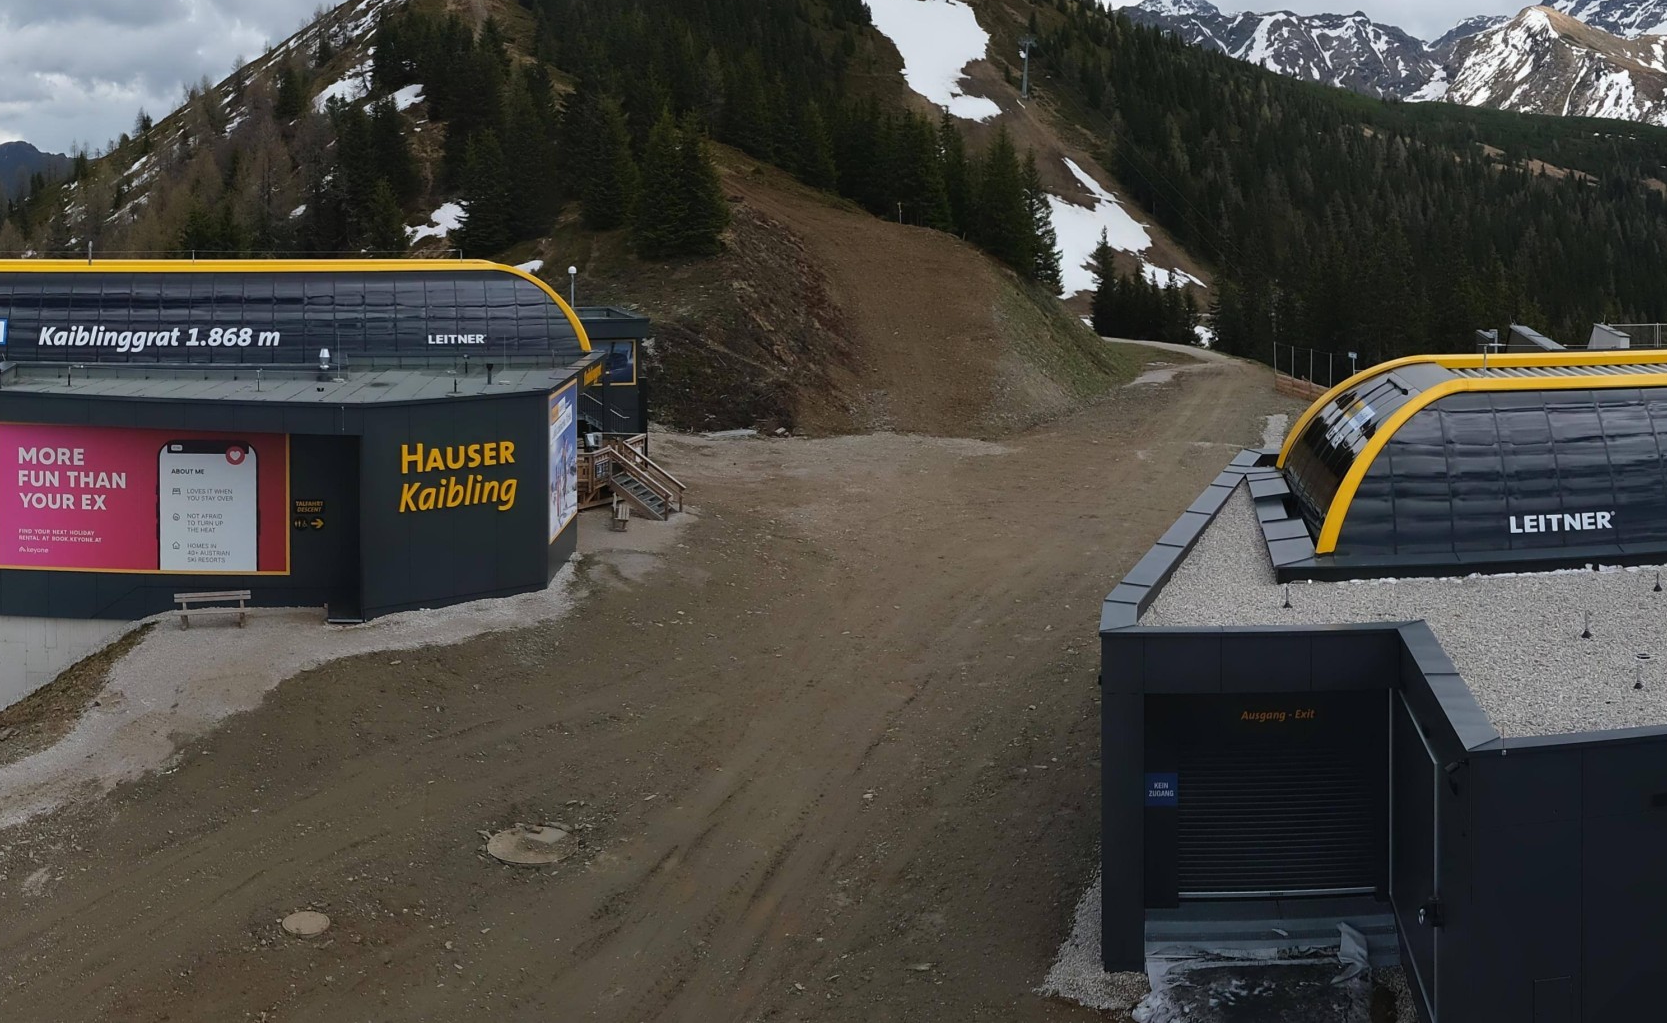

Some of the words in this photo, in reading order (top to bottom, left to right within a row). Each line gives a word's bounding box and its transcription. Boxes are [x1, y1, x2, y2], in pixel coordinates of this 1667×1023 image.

[38, 325, 180, 353] Kaiblinggrat
[185, 327, 252, 347] 1.868
[258, 331, 280, 347] m
[18, 447, 85, 465] MORE
[401, 441, 515, 474] HAUSER
[18, 470, 59, 487] FUN
[67, 471, 126, 489] THAN
[19, 493, 74, 509] YOUR
[81, 494, 106, 510] EX
[398, 475, 518, 513] Kaibling
[27, 546, 48, 554] keyone
[1240, 710, 1286, 723] Ausgang
[1295, 709, 1315, 719] Exit
